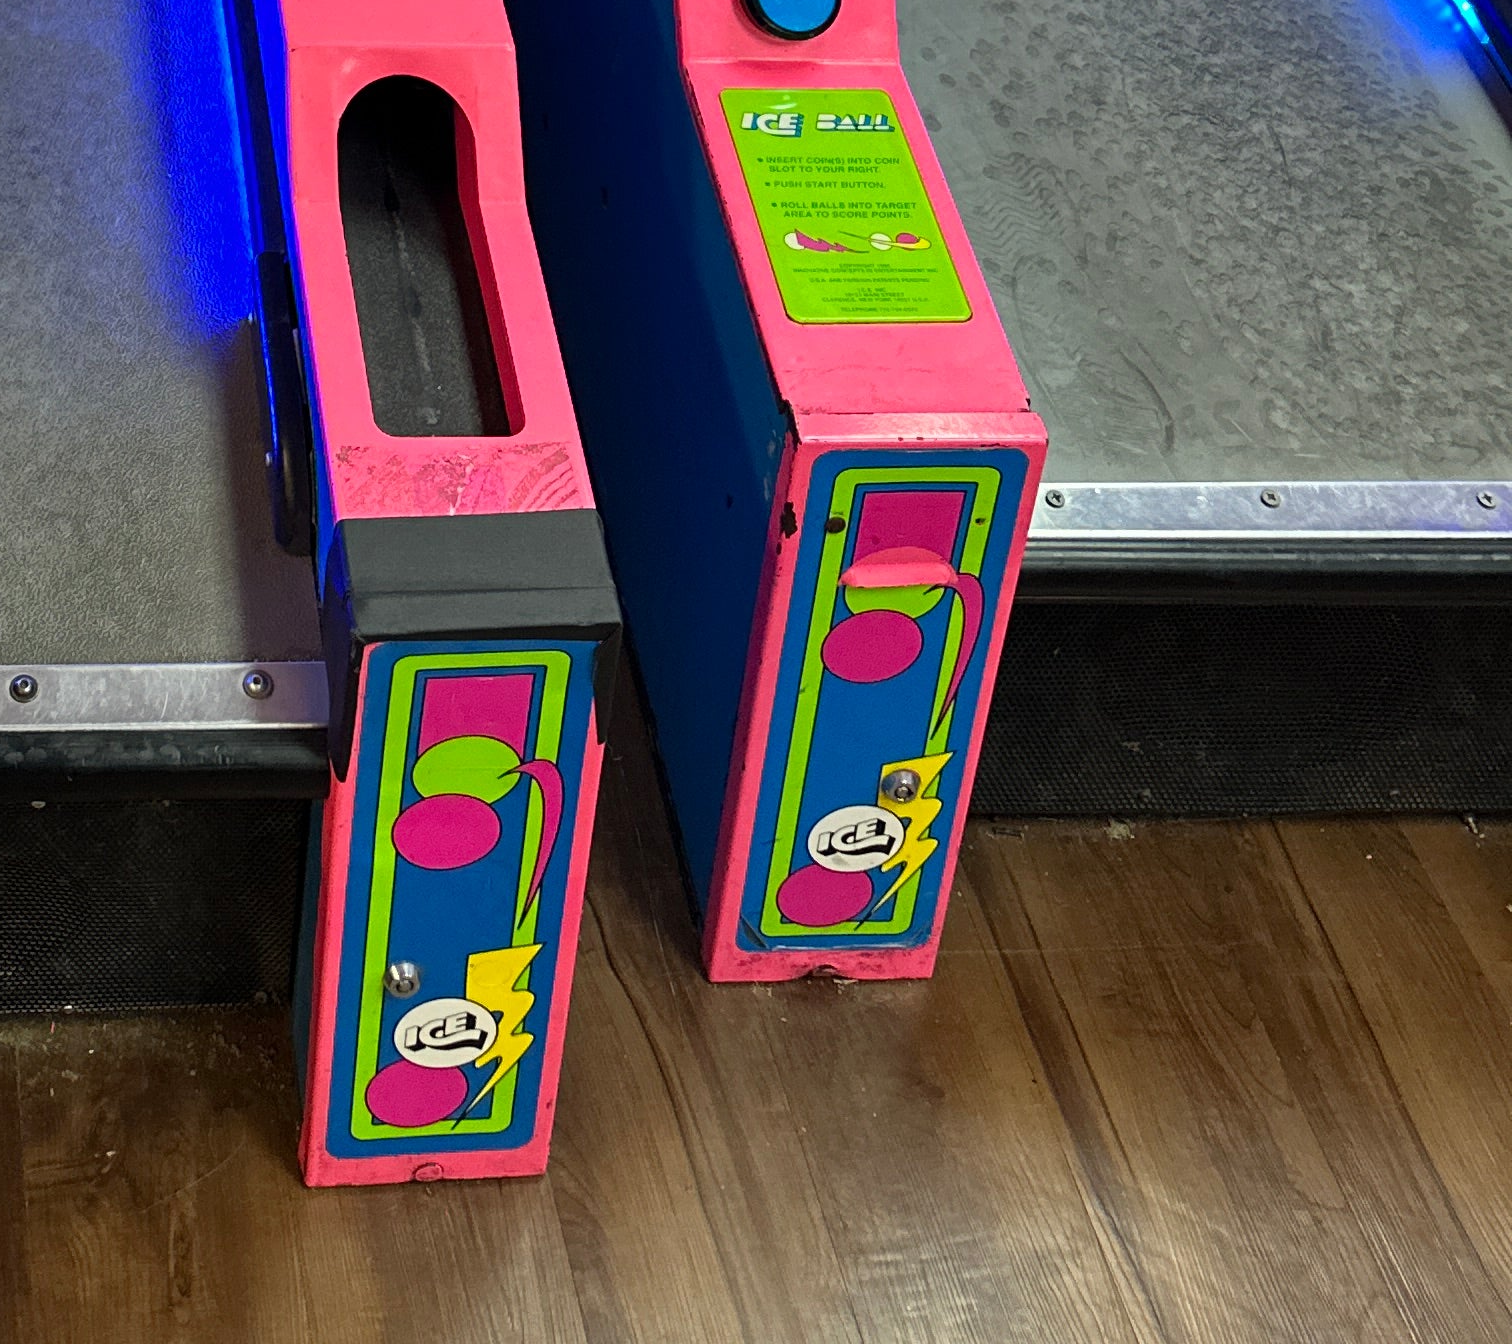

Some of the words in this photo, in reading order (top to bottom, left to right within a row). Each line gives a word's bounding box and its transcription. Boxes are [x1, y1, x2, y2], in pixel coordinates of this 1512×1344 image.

[741, 113, 804, 137] ICE
[816, 114, 895, 132] BALL
[806, 157, 844, 165] COIN(S)
[816, 815, 896, 857] ICE
[403, 1012, 487, 1053] ICE
